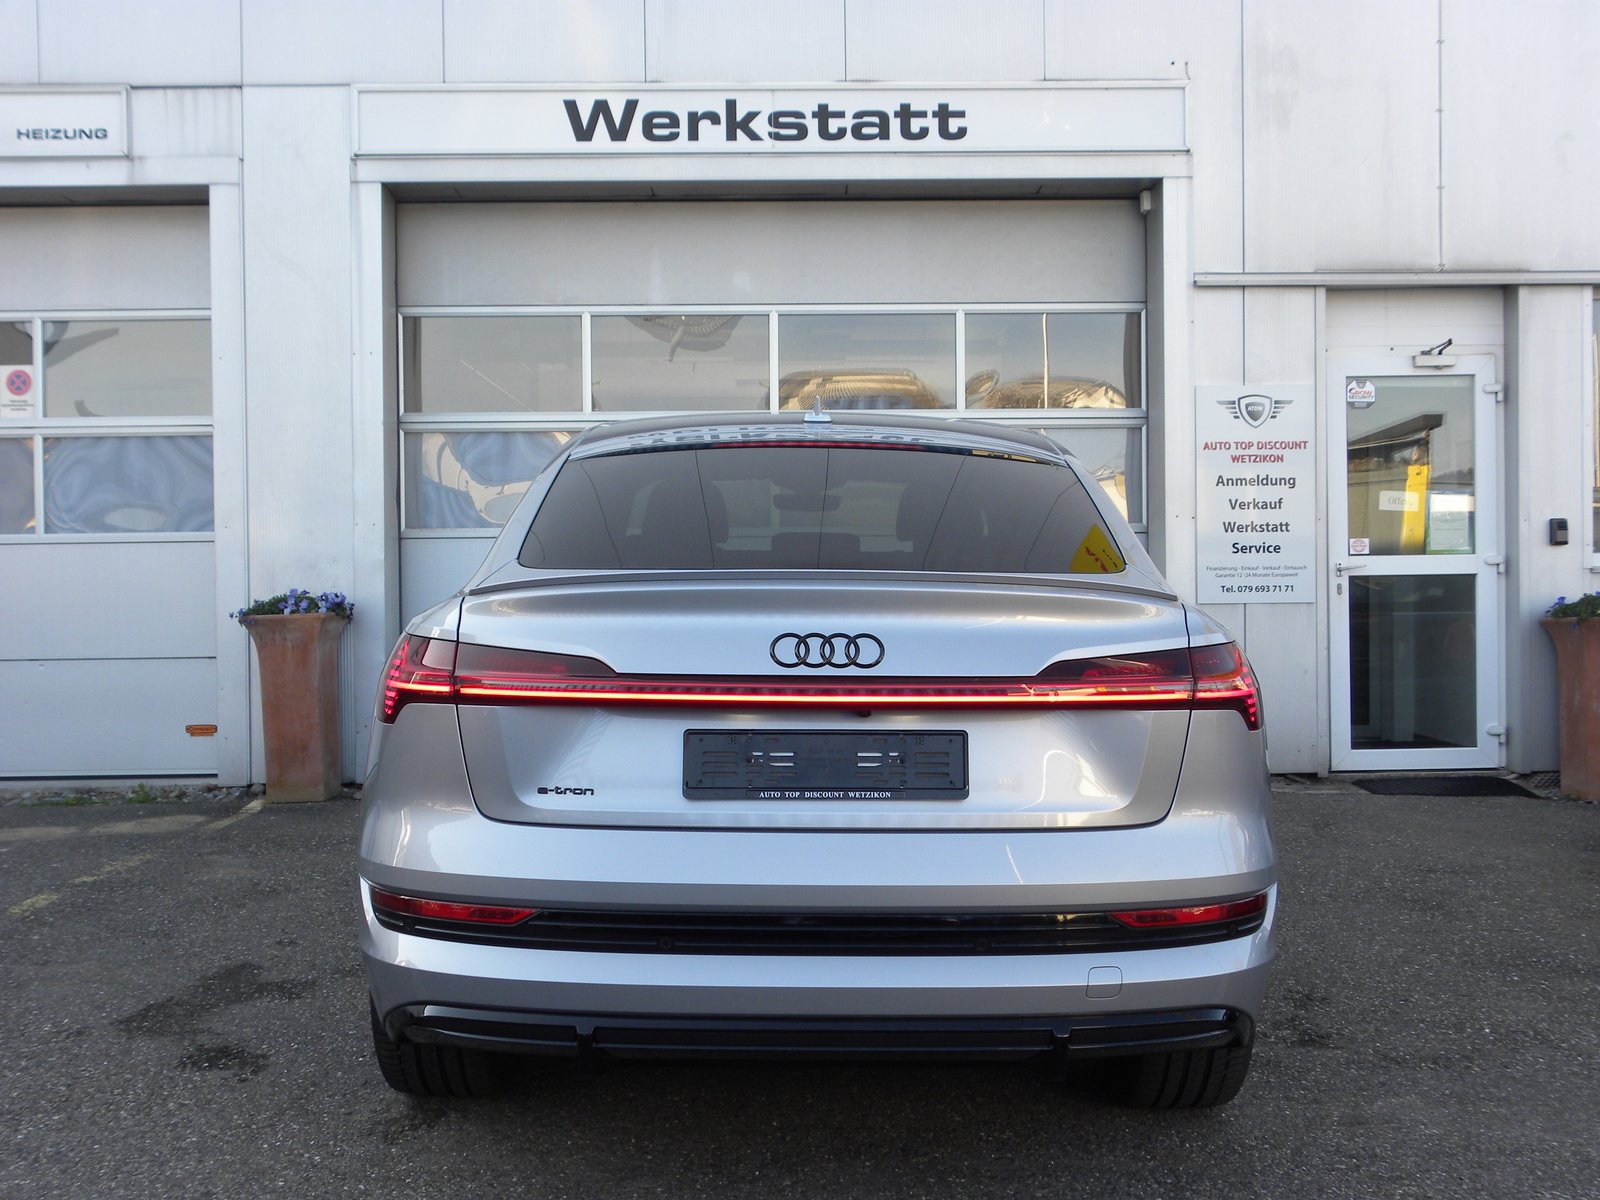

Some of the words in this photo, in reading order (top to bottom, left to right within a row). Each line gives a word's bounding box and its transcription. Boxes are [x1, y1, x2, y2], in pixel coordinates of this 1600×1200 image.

[562, 98, 968, 142] Werkstatt
[16, 128, 108, 140] HEIZUNG
[1203, 441, 1231, 450] AUTO
[1234, 441, 1254, 450] TOP
[1256, 441, 1308, 450] DISCOUNT
[1231, 454, 1284, 463] WETZIKON
[1216, 474, 1296, 489] Anmeldung
[1228, 497, 1283, 510] Verkauf
[1222, 520, 1290, 533] Werkstatt
[1232, 541, 1281, 554] Service
[1220, 585, 1236, 593] Tel.
[1237, 585, 1253, 593] 079
[1255, 585, 1270, 593] 693
[1272, 585, 1282, 593] 71
[537, 785, 595, 796] e-tron
